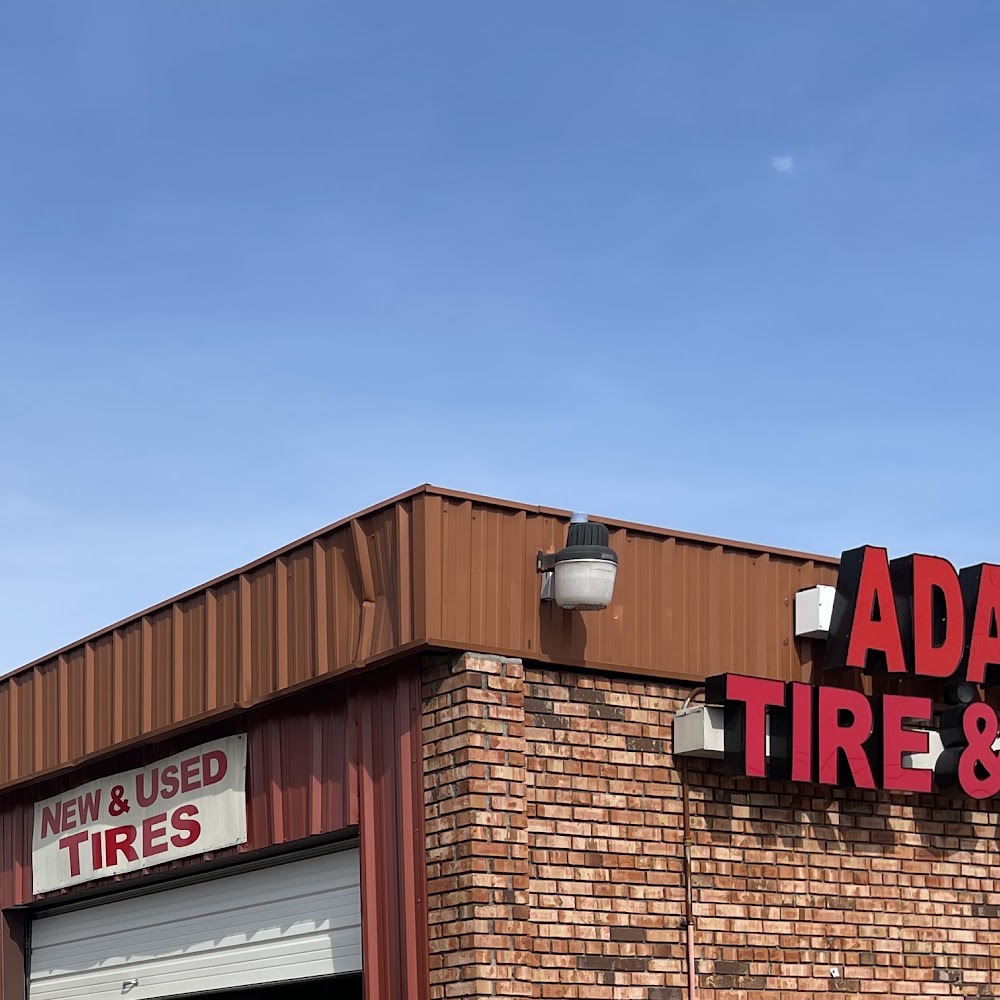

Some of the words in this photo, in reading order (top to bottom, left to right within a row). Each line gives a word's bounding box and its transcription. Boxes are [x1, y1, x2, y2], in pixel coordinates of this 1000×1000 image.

[726, 673, 932, 793] TIRE
[958, 702, 1000, 799] &
[40, 788, 102, 840] NEW
[108, 785, 131, 817] &
[135, 750, 228, 808] USED
[59, 804, 202, 878] TIRES
